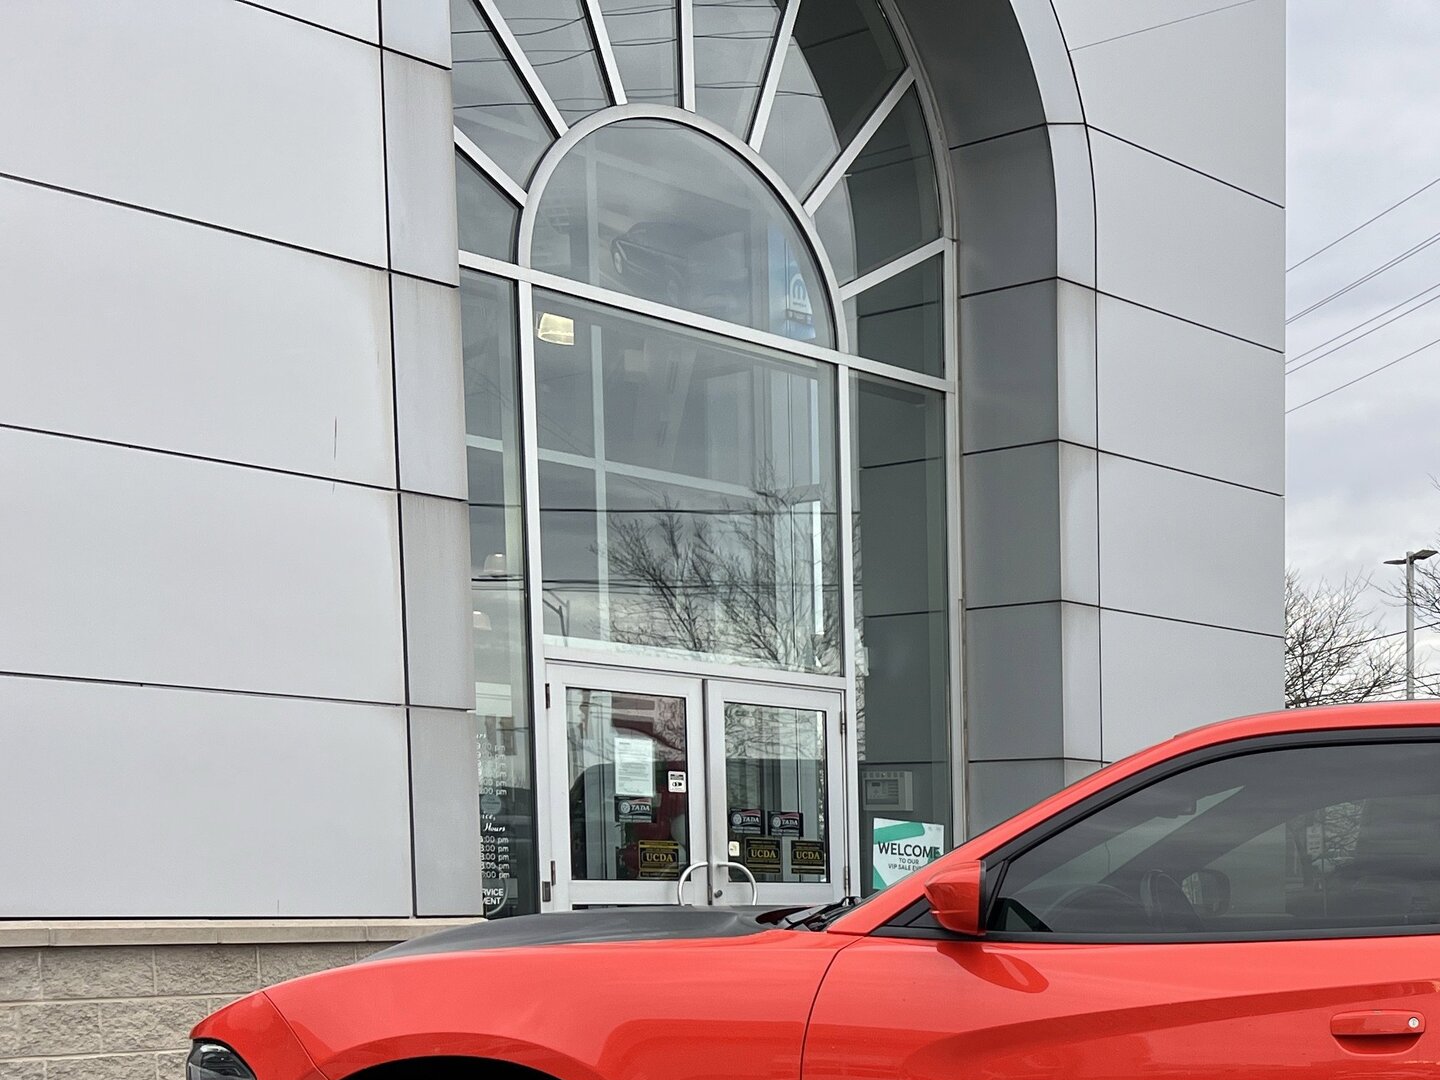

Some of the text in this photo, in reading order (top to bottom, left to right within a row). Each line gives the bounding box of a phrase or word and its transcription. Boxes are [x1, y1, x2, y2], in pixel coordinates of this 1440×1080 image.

[495, 788, 507, 796] pm
[631, 803, 651, 812] TADA
[742, 815, 760, 823] TADA
[483, 822, 506, 832] Hours
[497, 837, 509, 845] pm
[497, 846, 509, 854] pm
[750, 849, 777, 858] UCDA
[878, 841, 941, 859] WELCOME
[498, 854, 510, 862] pm
[646, 853, 674, 863] UCDA
[795, 851, 821, 860] UCDA
[498, 863, 510, 871] pm
[498, 872, 510, 880] pm
